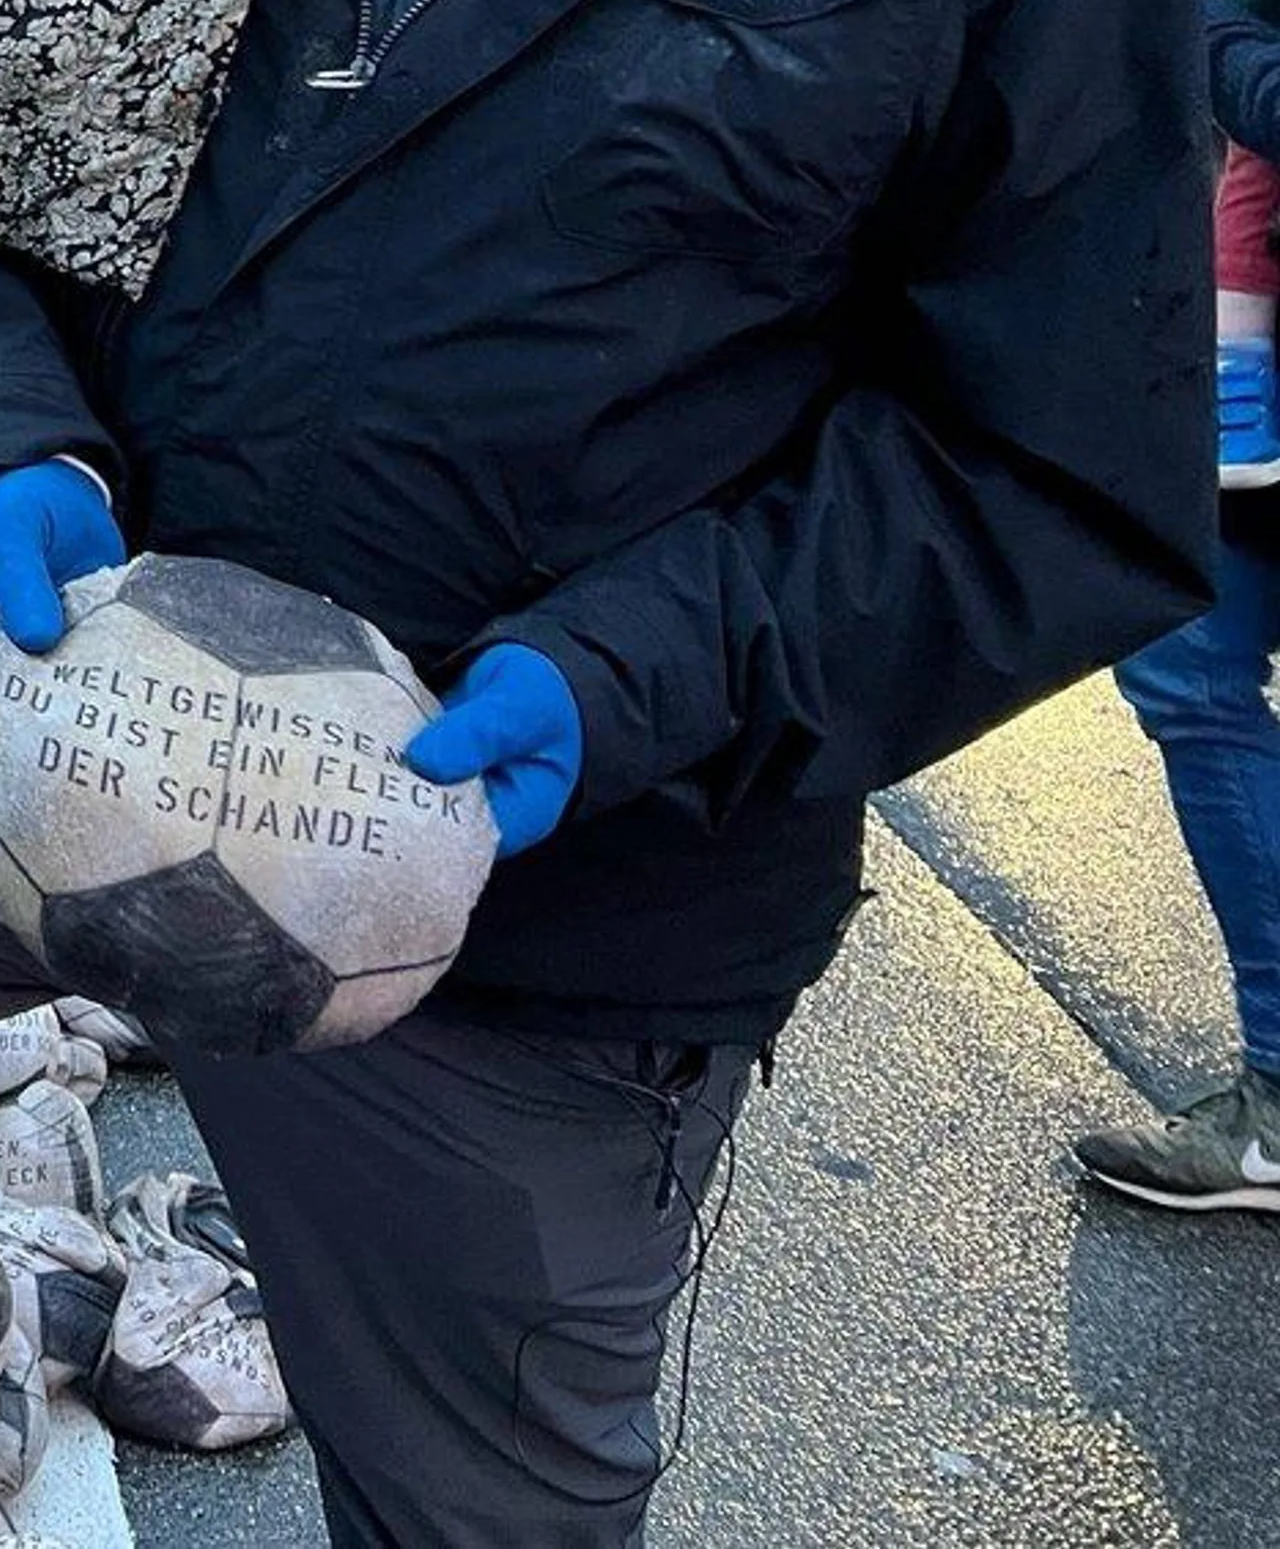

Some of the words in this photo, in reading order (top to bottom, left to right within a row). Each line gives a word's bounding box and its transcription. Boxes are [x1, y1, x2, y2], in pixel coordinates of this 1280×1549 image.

[4, 674, 52, 714] DU
[75, 702, 180, 759] BIST
[208, 739, 286, 777] EIN
[314, 759, 465, 824] FLECK
[37, 737, 125, 797] DER
[155, 778, 404, 860] SCHANDE.
